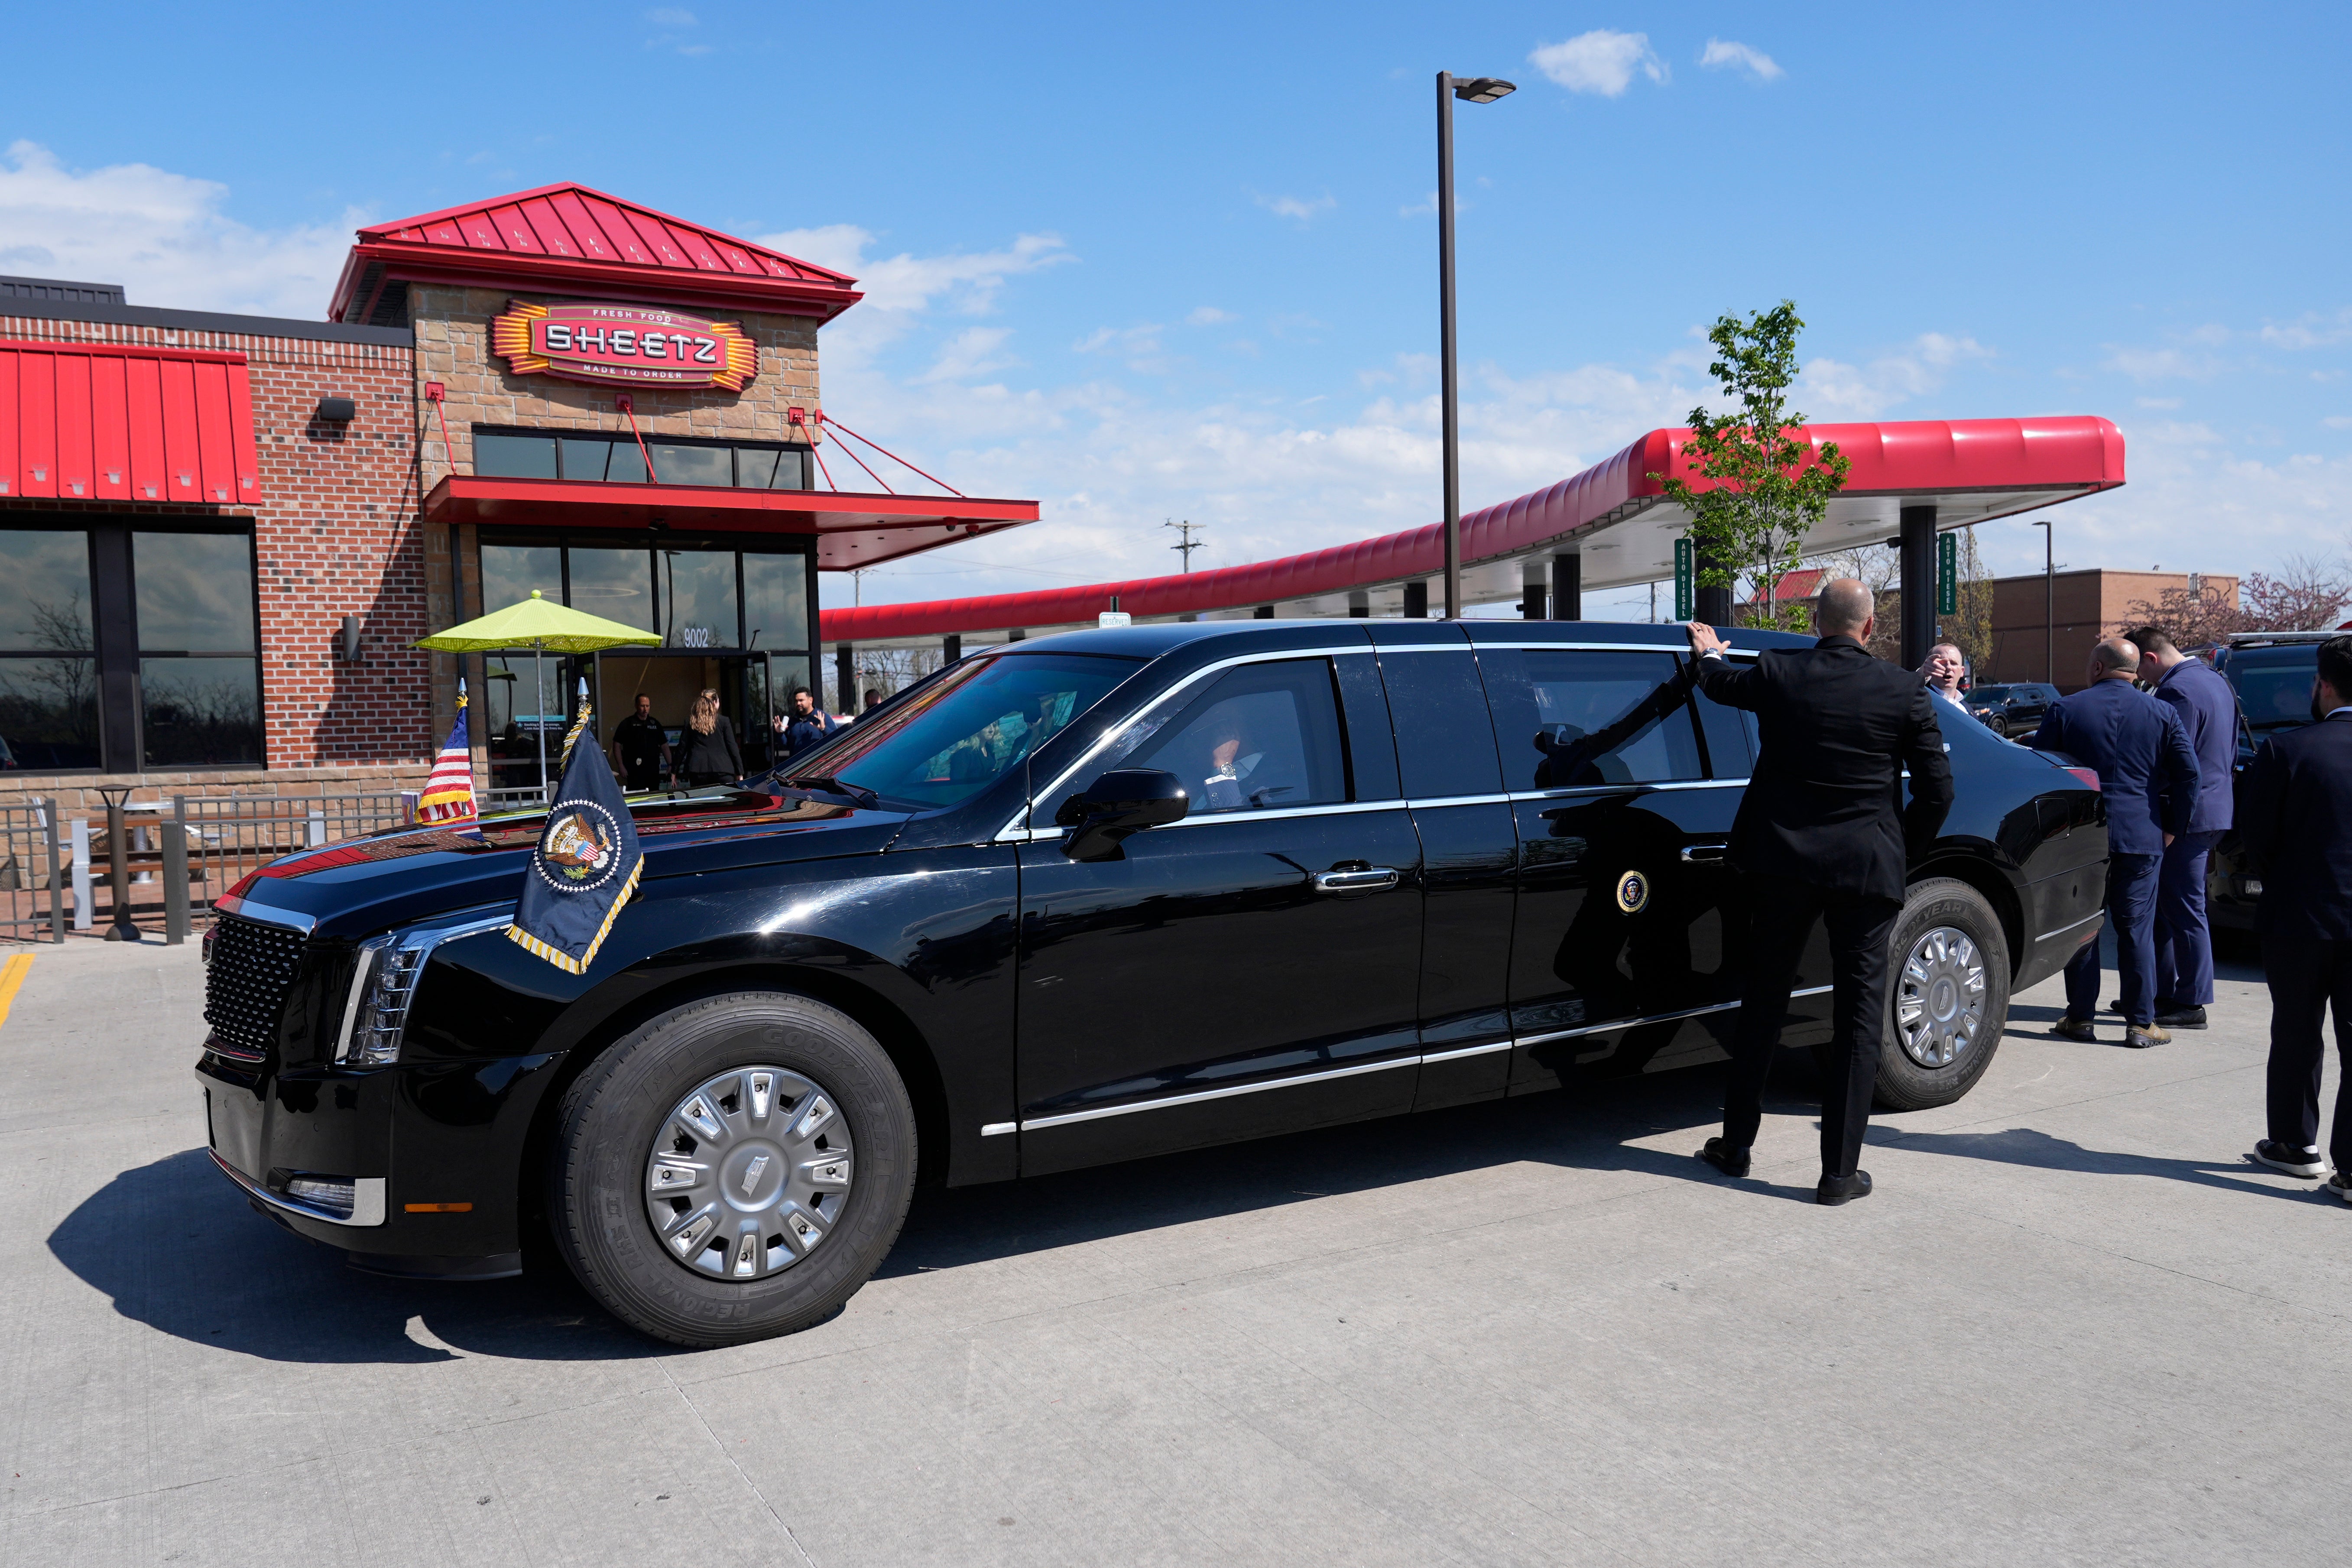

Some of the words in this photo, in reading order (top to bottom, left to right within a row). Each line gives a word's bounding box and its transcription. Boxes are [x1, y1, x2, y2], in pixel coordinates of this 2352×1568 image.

[593, 309, 632, 318] FRESH
[641, 313, 671, 323] FOOD
[546, 324, 716, 363] SHEETZ
[583, 364, 616, 374] MADE
[643, 370, 682, 379] ORDER
[685, 628, 708, 648] 9002
[782, 1052, 812, 1066] TUBELESS
[762, 1028, 889, 1152] GOODYEAR
[611, 1225, 645, 1270] RHS
[646, 1275, 751, 1319] REGIONAL
